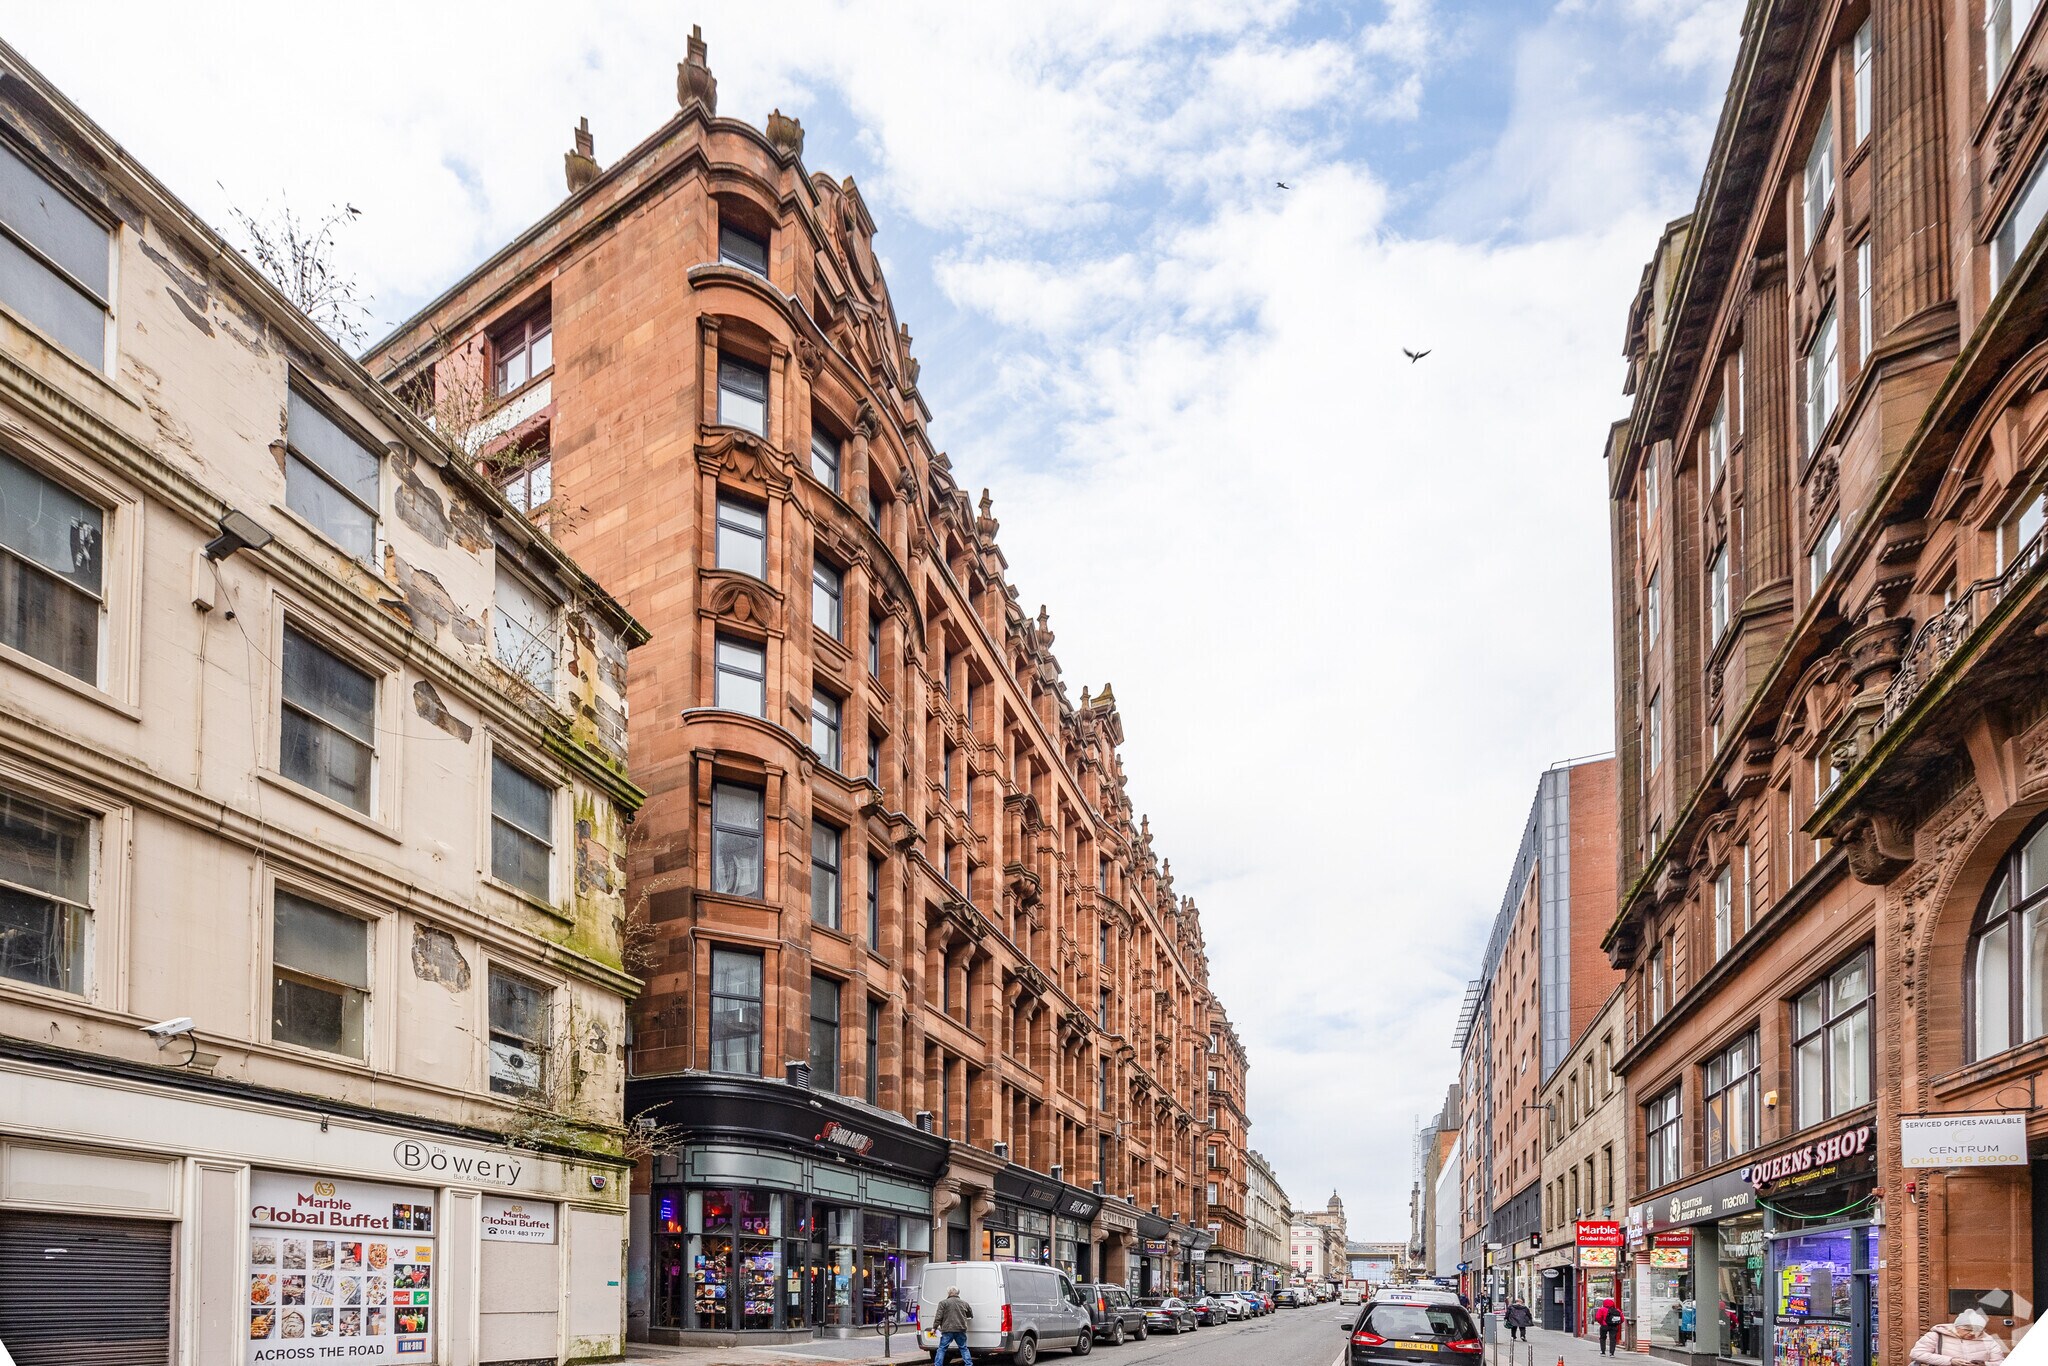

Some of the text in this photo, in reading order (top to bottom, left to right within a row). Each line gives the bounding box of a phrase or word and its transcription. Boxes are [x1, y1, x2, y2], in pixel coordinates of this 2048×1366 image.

[1943, 1119, 1977, 1127] OFFICES
[1978, 1117, 2022, 1126] AVAILABLE
[433, 1146, 447, 1155] The
[1929, 1145, 1999, 1155] CENTRUM
[1751, 1125, 1870, 1190] QUEENS SHOP
[1910, 1154, 2019, 1165] 0141 548 8000
[404, 1144, 522, 1186] Bowery
[1778, 1166, 1836, 1188] Local Convenience Store
[297, 1192, 352, 1211] Marble
[1681, 1196, 1703, 1210] SCOTTISH
[1722, 1192, 1749, 1210] macron
[251, 1205, 390, 1230] Global Buffet
[503, 1210, 531, 1220] Marble
[1681, 1204, 1713, 1221] RUGBY STORE
[481, 1216, 550, 1230] Global Buffet
[1579, 1224, 1617, 1235] Marble
[1740, 1229, 1764, 1244] BECOME
[1790, 1316, 1800, 1325] Shop
[254, 1344, 386, 1361] ACROSS THE ROAD
